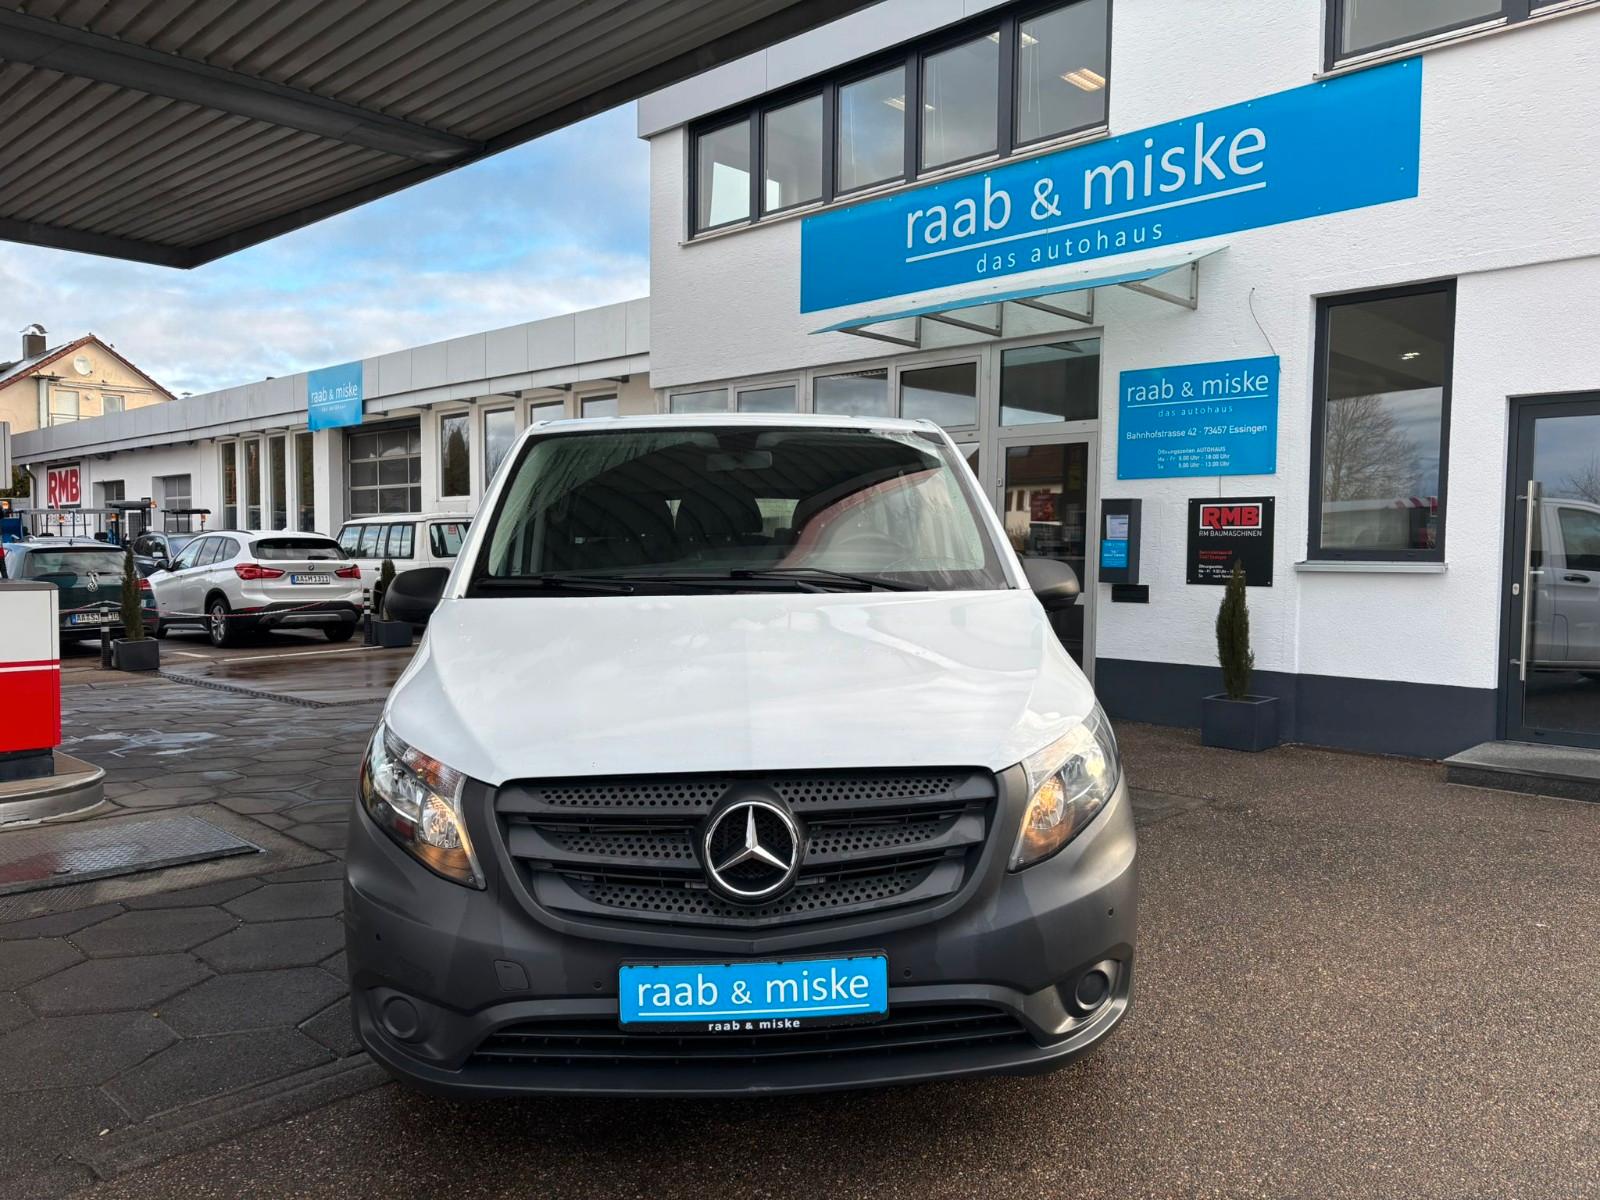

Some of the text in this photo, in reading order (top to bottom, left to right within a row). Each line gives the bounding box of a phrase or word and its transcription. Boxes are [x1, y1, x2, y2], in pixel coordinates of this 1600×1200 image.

[906, 122, 1267, 249] raab & miske
[976, 223, 1163, 273] das autohaus
[311, 387, 328, 403] raab
[335, 382, 358, 399] miske
[1127, 370, 1269, 402] raab & miske
[1158, 405, 1233, 418] das autohaus
[1126, 429, 1186, 440] Bahnhofstrasse
[1187, 427, 1197, 437] 42
[1203, 425, 1228, 435] 73457
[1229, 424, 1268, 435] Essingen
[48, 469, 80, 509] RMB
[1203, 506, 1259, 530] RMB
[638, 967, 870, 1007] raab & miske
[708, 1018, 801, 1032] raab & miske
